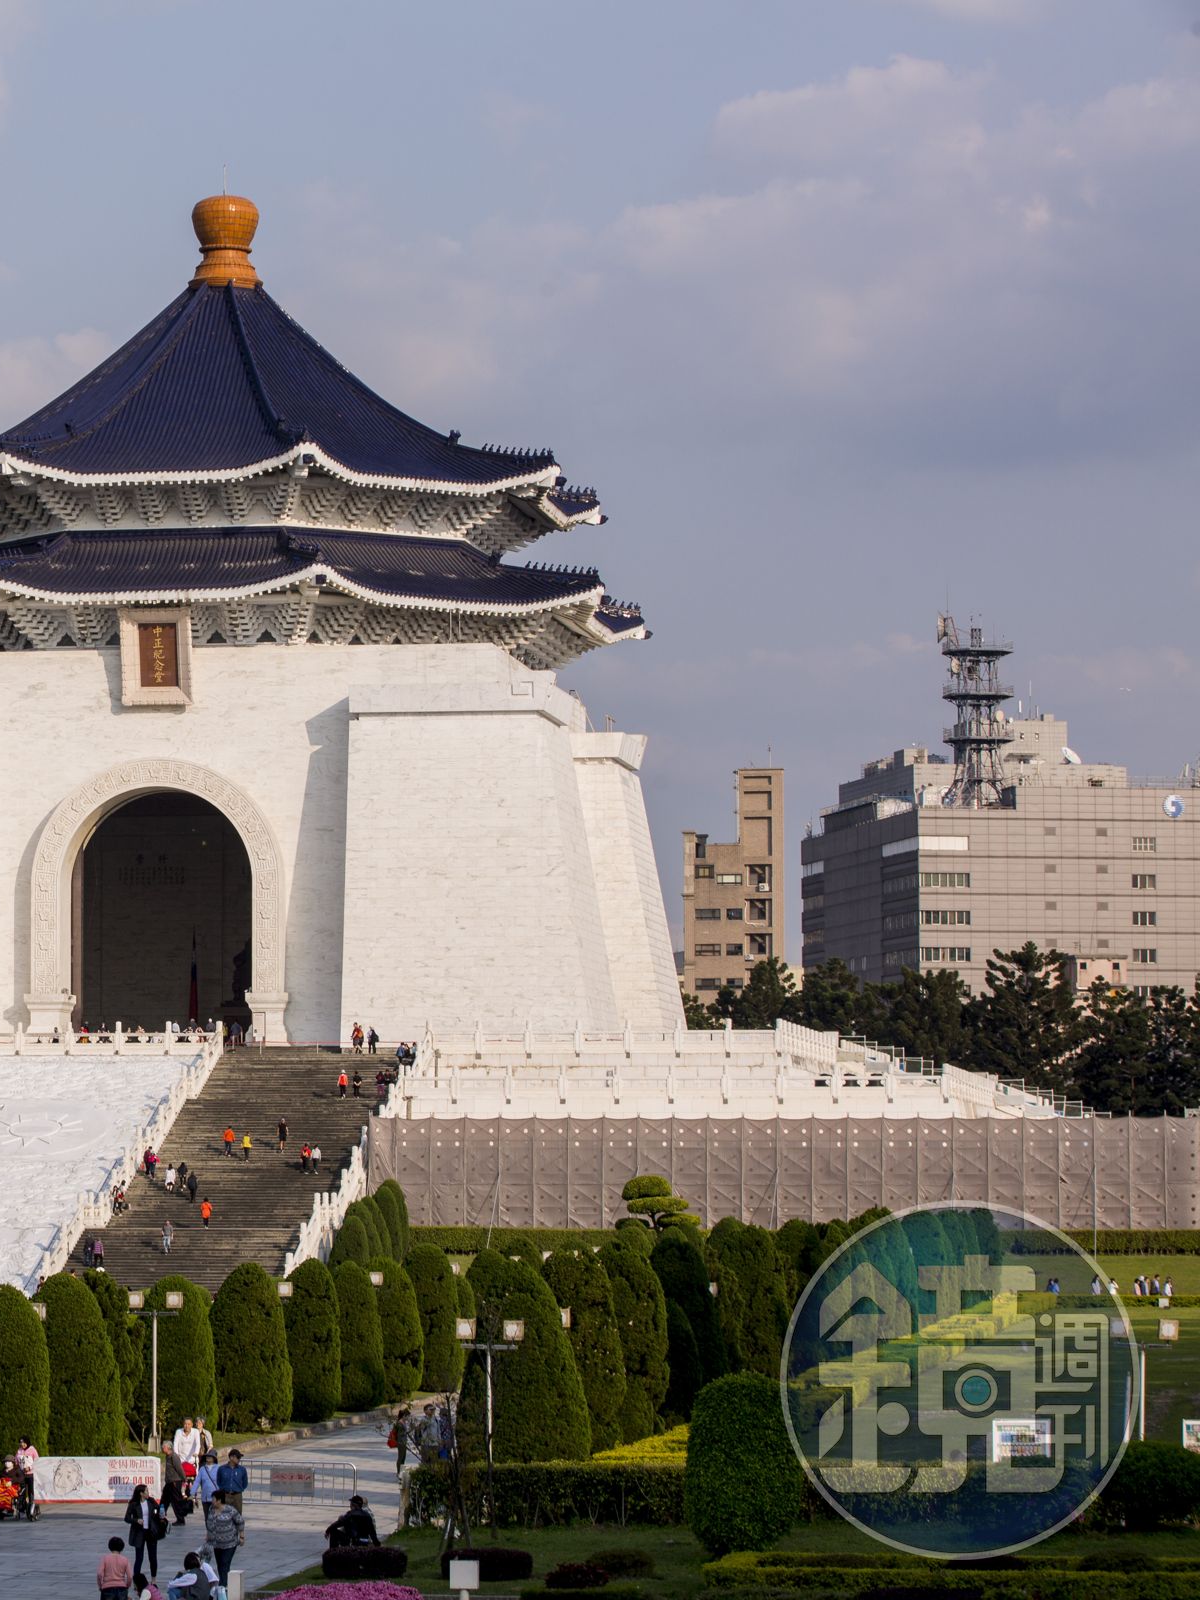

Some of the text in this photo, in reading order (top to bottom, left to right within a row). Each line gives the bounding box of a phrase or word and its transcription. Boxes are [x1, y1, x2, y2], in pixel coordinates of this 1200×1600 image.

[152, 625, 165, 683] 中正紀念堂
